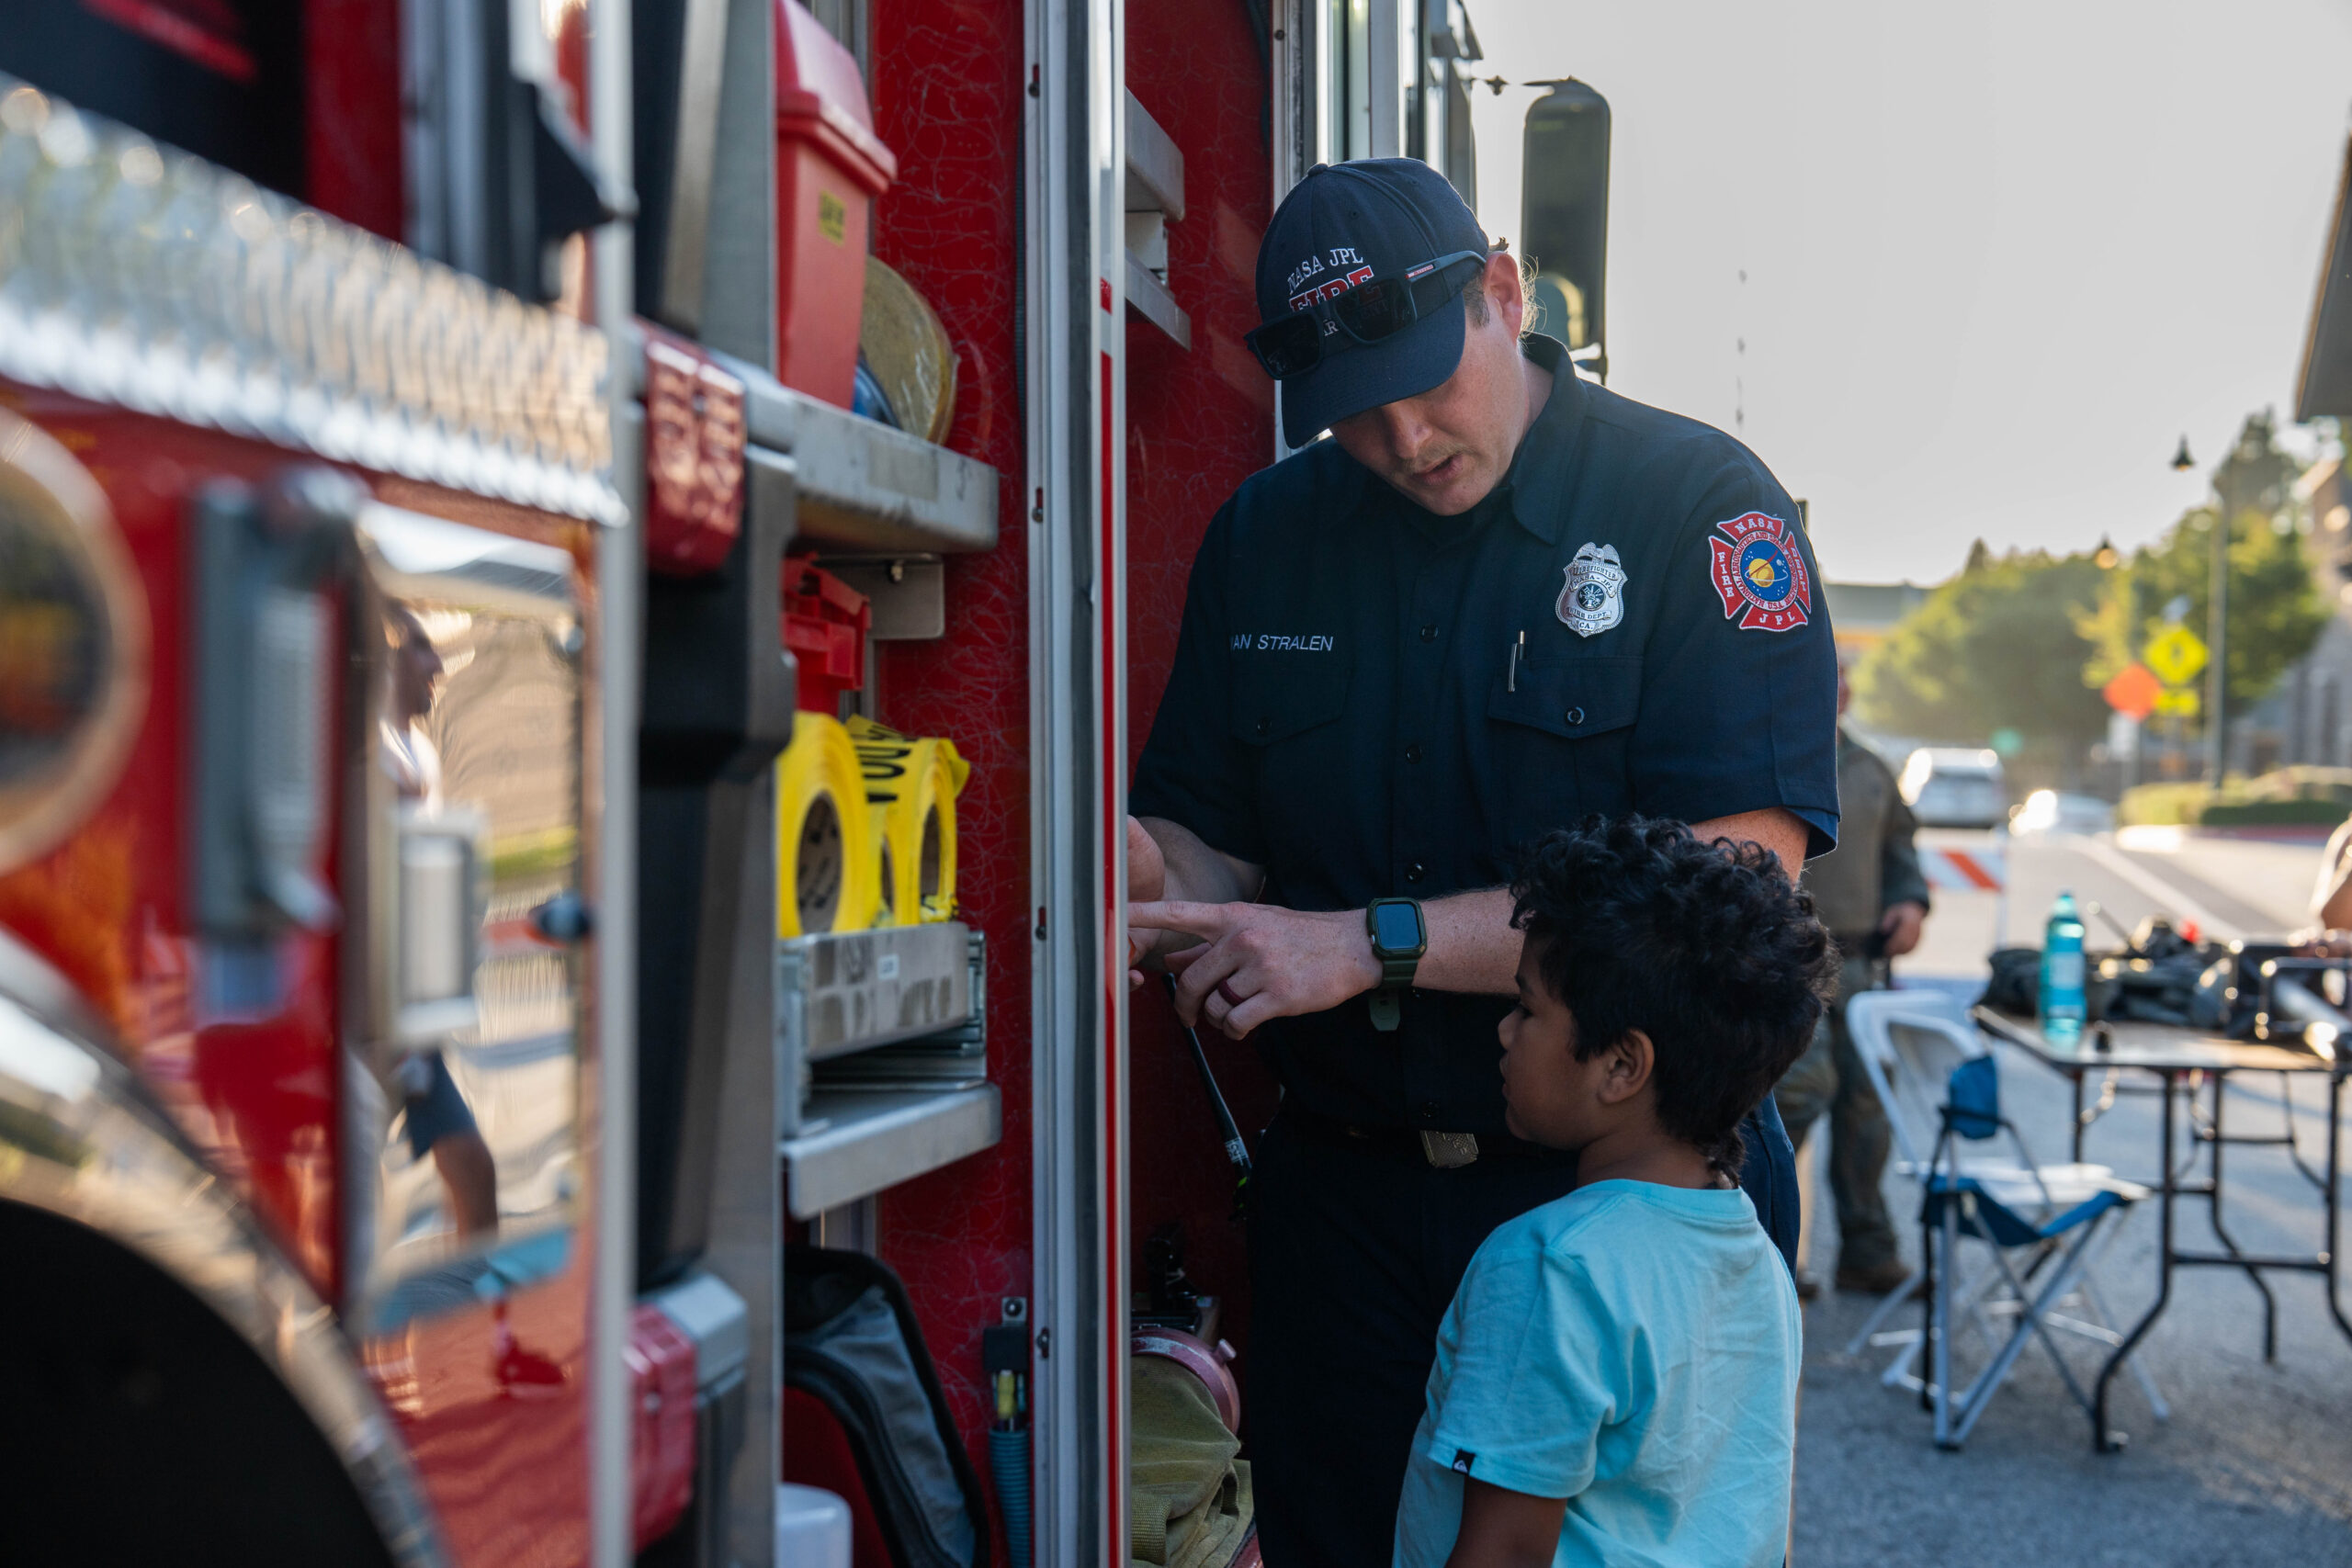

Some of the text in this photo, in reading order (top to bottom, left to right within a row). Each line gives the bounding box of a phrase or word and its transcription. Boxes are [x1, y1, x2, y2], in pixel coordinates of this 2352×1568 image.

[1287, 248, 1363, 294] NASA JPL
[1735, 517, 1775, 534] NASA
[1716, 552, 1736, 598] FIRE
[1578, 622, 1594, 630] CA.
[1758, 611, 1795, 626] JPL
[1257, 634, 1334, 651] STRALEN
